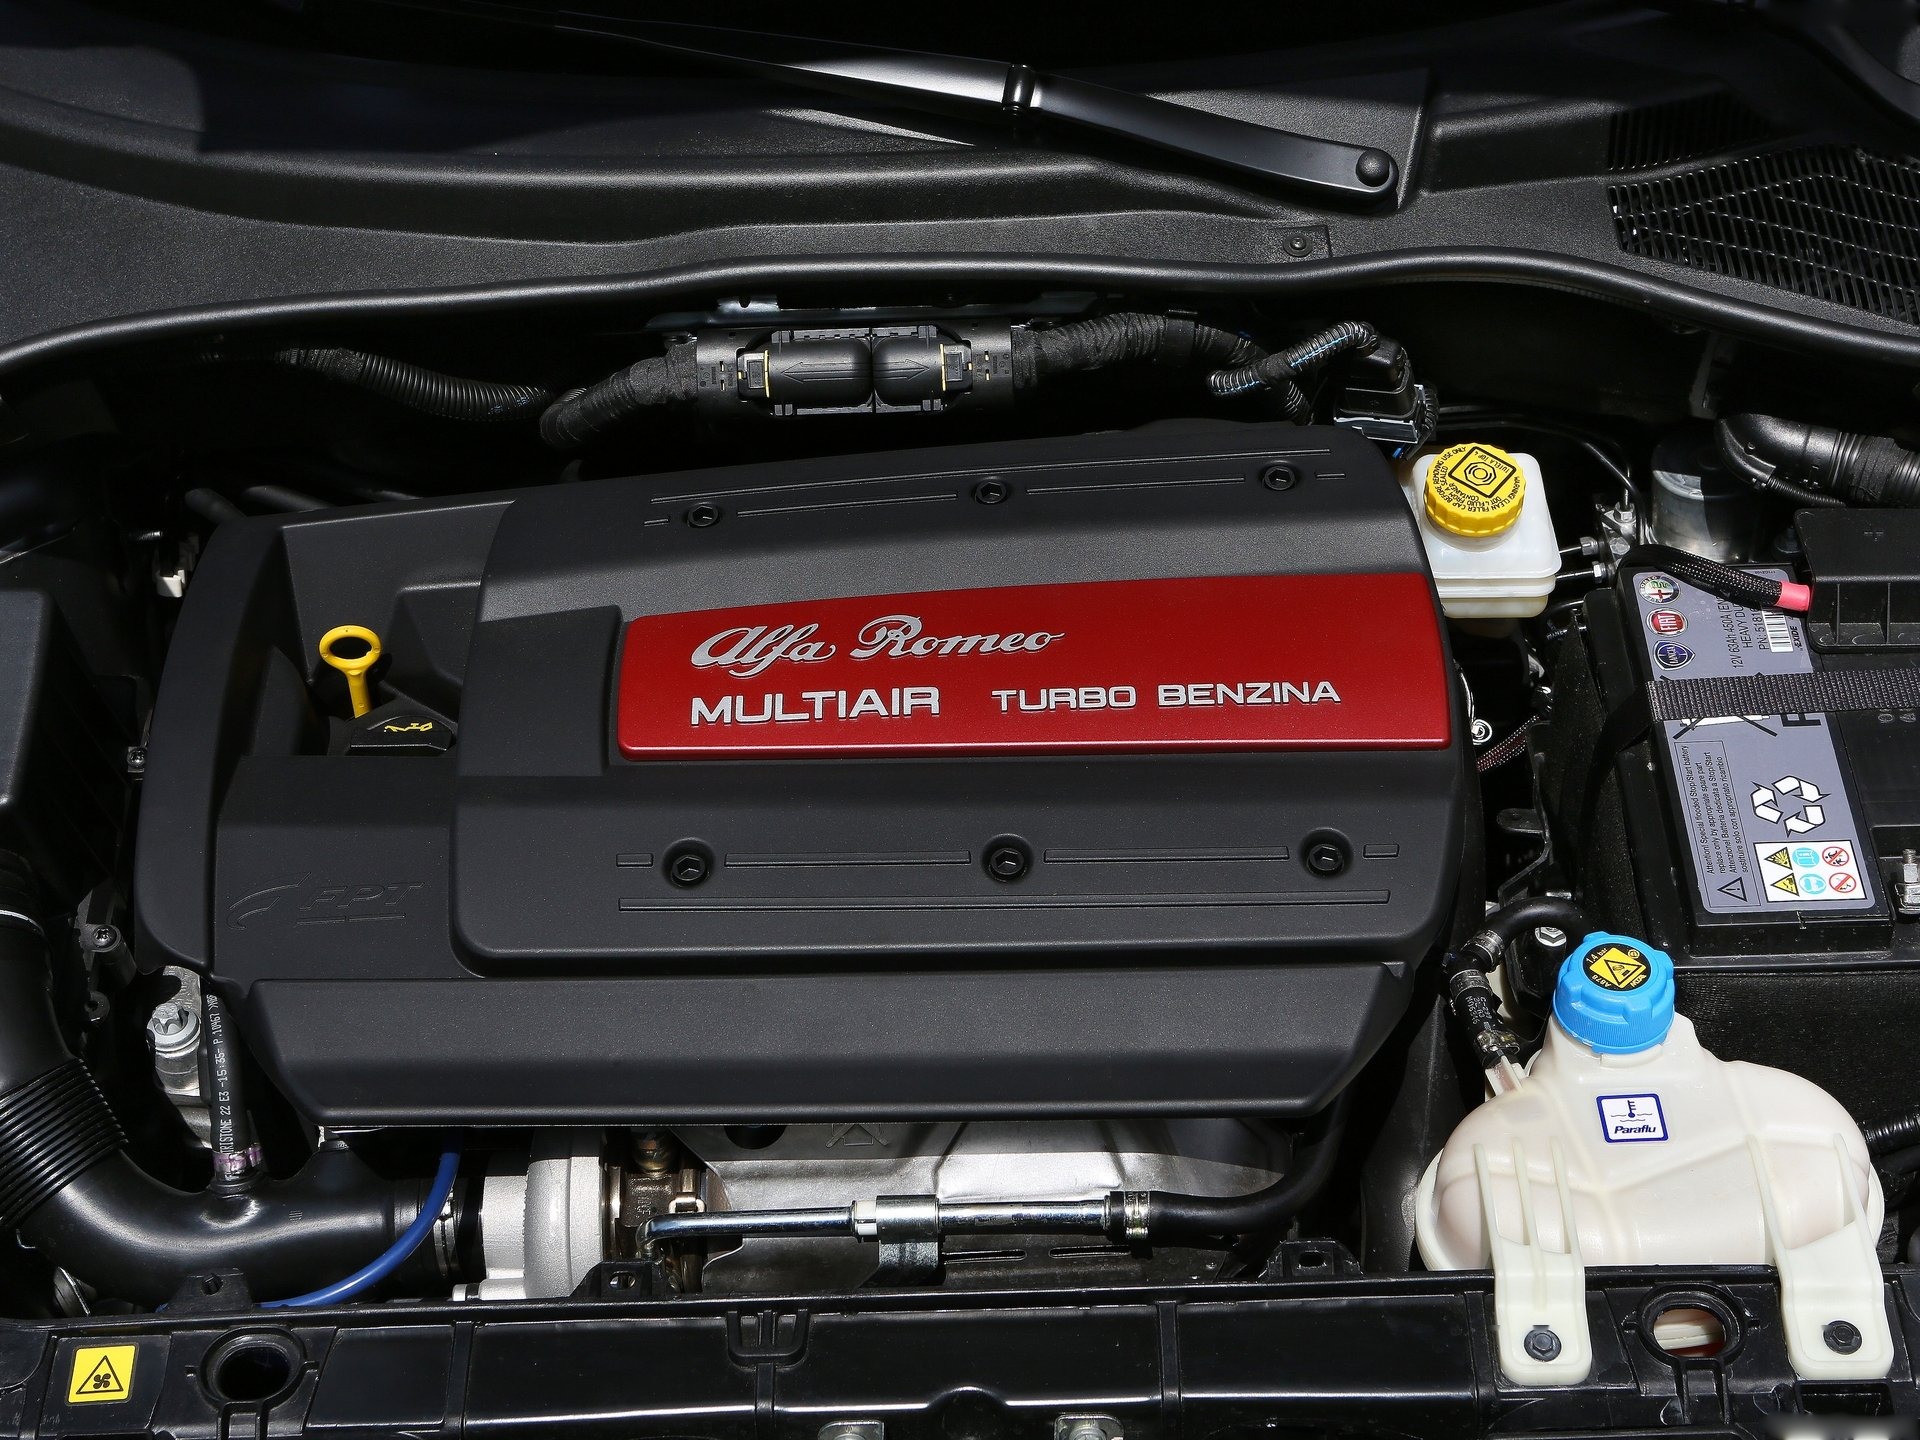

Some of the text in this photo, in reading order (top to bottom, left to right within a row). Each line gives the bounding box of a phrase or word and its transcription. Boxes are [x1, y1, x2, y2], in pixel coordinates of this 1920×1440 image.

[1441, 451, 1453, 460] USE
[1452, 446, 1467, 454] ONLY
[1432, 460, 1444, 484] REMOVING
[1440, 465, 1448, 486] SEALED
[1435, 486, 1453, 503] BEFORE
[1449, 482, 1480, 500] CONTAINER
[1449, 492, 1465, 504] FROM
[1490, 496, 1502, 504] DOT
[1452, 502, 1466, 510] CAP
[1491, 499, 1510, 511] CLEAN
[1657, 614, 1679, 632] FIAT
[1720, 613, 1735, 633] 450A
[1733, 602, 1753, 649] HEAVY DU
[691, 614, 1064, 679] Alfa Romeo
[1725, 633, 1741, 653] 63Ah
[1757, 632, 1770, 651] PN:
[1789, 625, 1802, 648] EXIDE
[1730, 653, 1744, 669] 12V
[690, 687, 941, 727] MULTIAIR
[991, 681, 1341, 714] TURBO BENZINA
[1681, 745, 1690, 767] battery
[1695, 762, 1703, 777] part
[1704, 751, 1716, 782] Stop/Start
[1686, 766, 1697, 798] Stop/Start
[1699, 777, 1708, 794] spare
[1692, 798, 1702, 821] flooded
[1713, 787, 1724, 814] dedicata
[1703, 794, 1717, 829] appropriate
[1716, 756, 1749, 873] sostituire solo con appropriato ricambio
[1697, 821, 1708, 844] Special
[1719, 814, 1730, 839] Batteria
[1712, 839, 1721, 854] only
[1716, 854, 1727, 874] replace
[298, 882, 426, 910] FPT
[1585, 947, 1608, 964] 1.4 bar
[218, 1090, 230, 1103] E3
[218, 1105, 232, 1116] 22
[220, 1119, 234, 1154] TRISTONE
[1613, 1124, 1657, 1135] Paraflu
